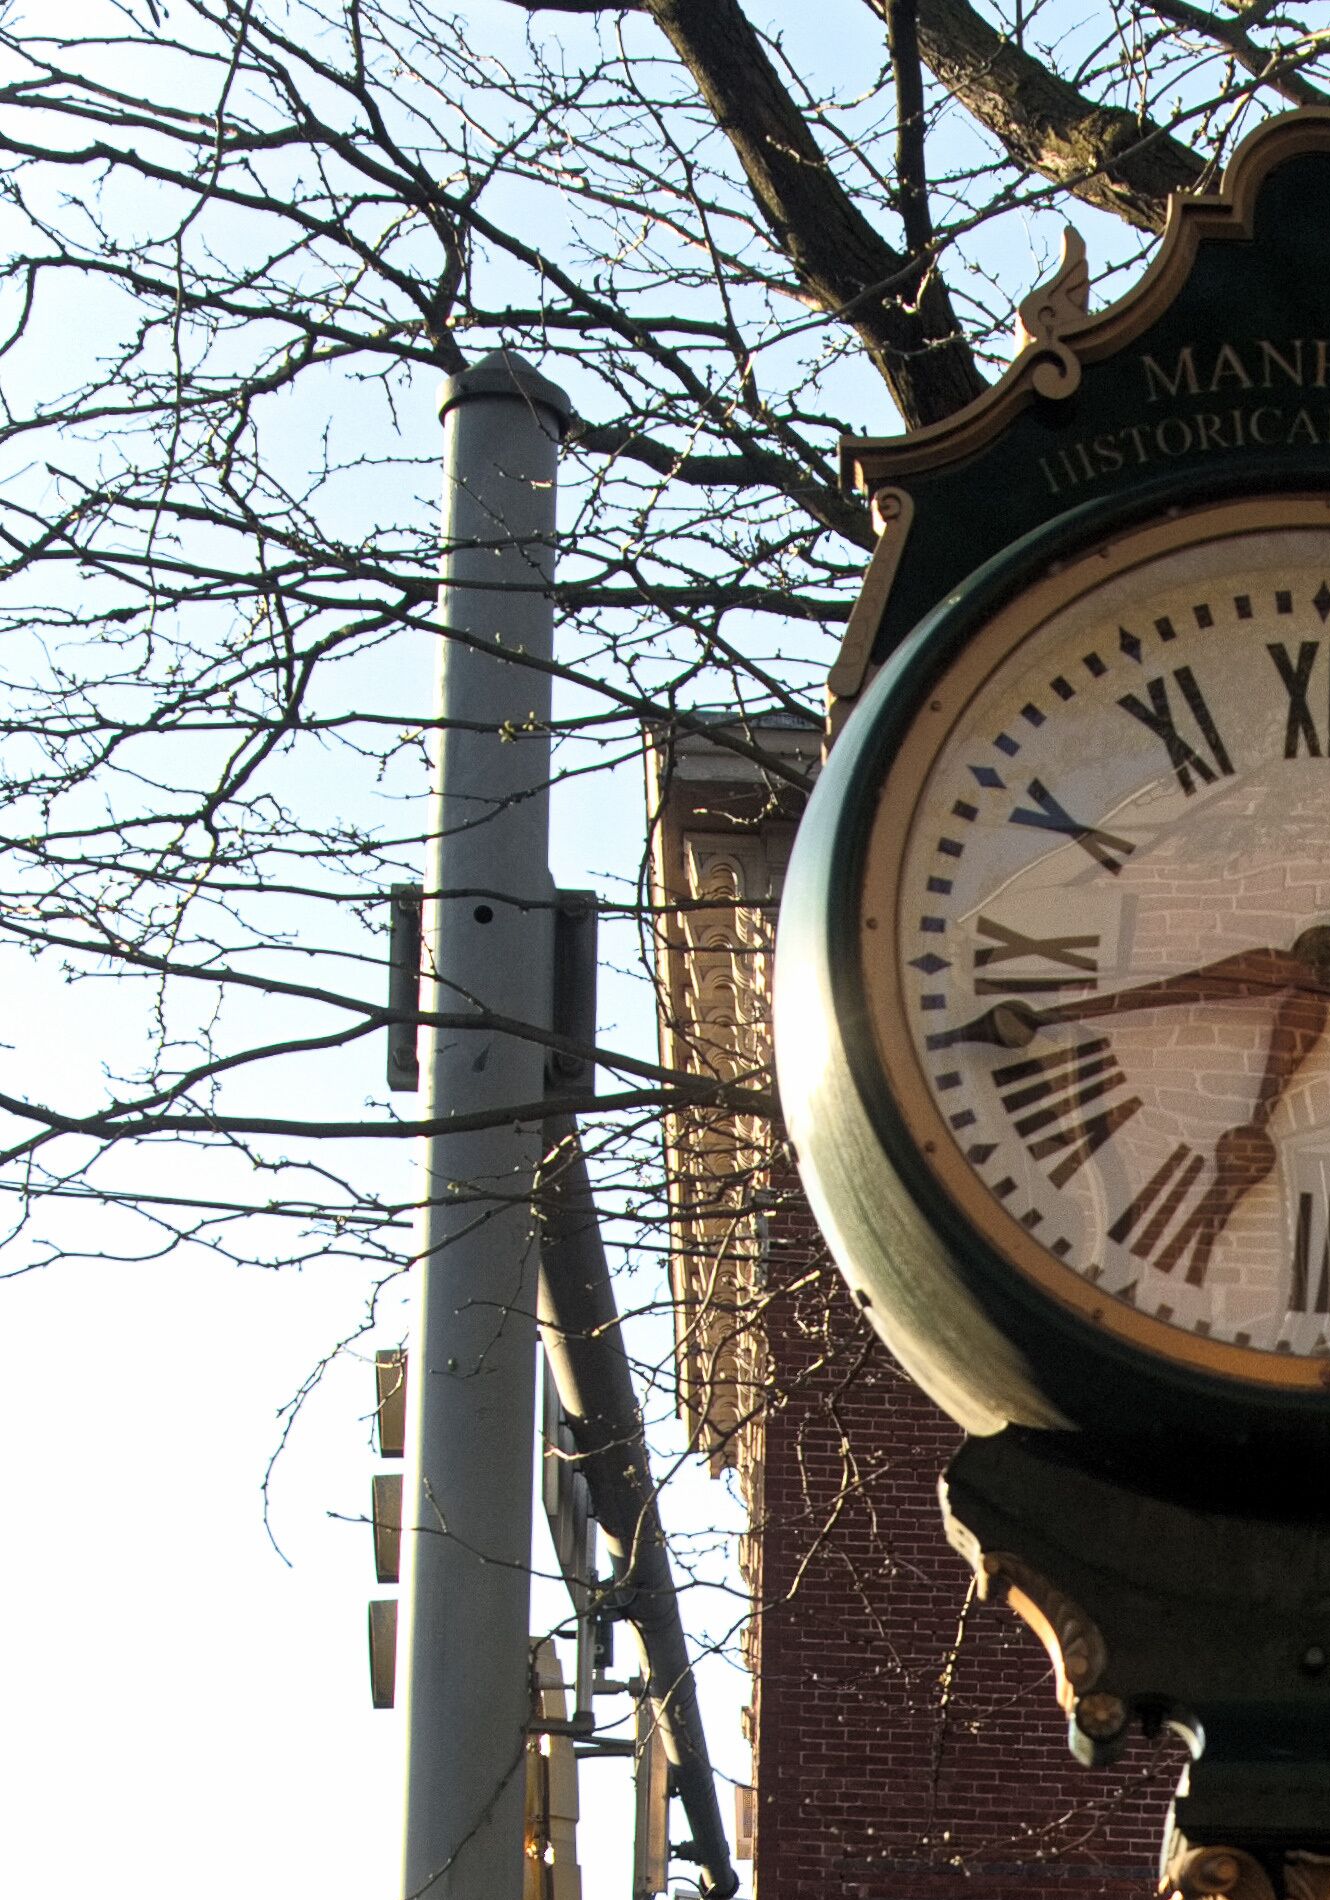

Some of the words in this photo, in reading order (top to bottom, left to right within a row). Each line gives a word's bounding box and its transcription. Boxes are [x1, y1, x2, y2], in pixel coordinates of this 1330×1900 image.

[1117, 665, 1235, 796] XI
[1009, 778, 1136, 875] X
[974, 916, 1101, 995] IX
[992, 1038, 1144, 1188] VIII
